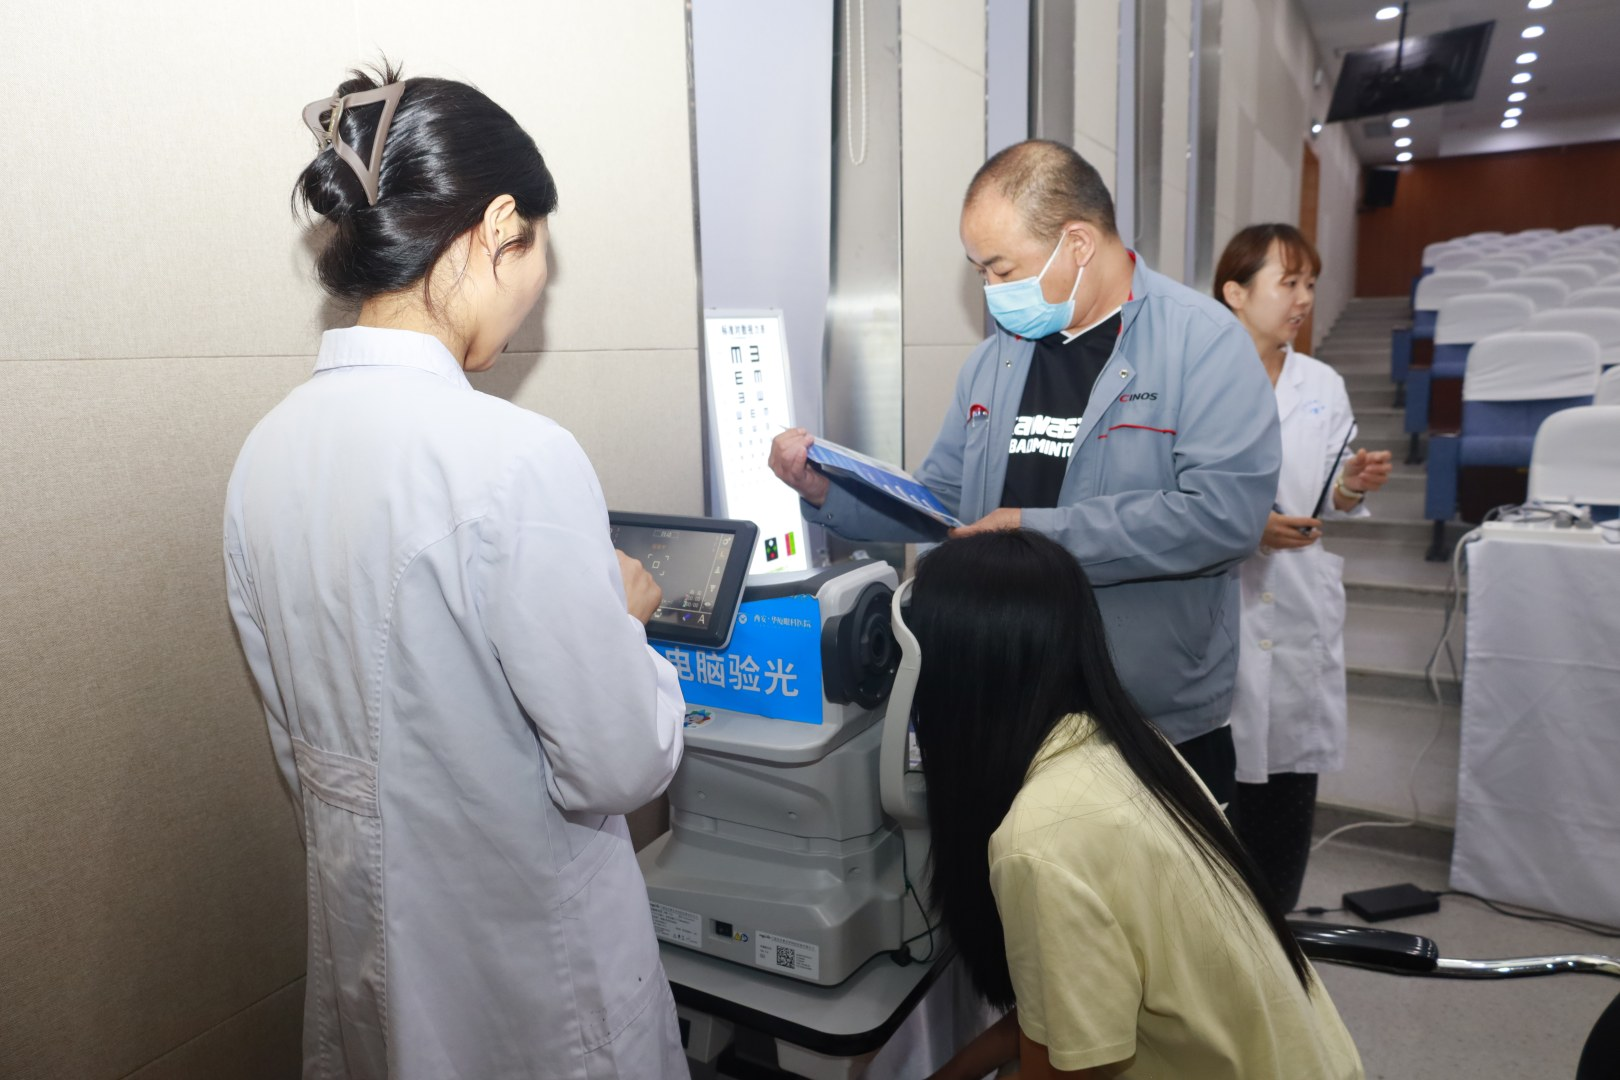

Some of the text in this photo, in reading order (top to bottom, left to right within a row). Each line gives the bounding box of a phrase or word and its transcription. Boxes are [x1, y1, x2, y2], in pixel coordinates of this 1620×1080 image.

[1119, 391, 1159, 403] CINOS
[665, 646, 799, 697] 电脑验光
